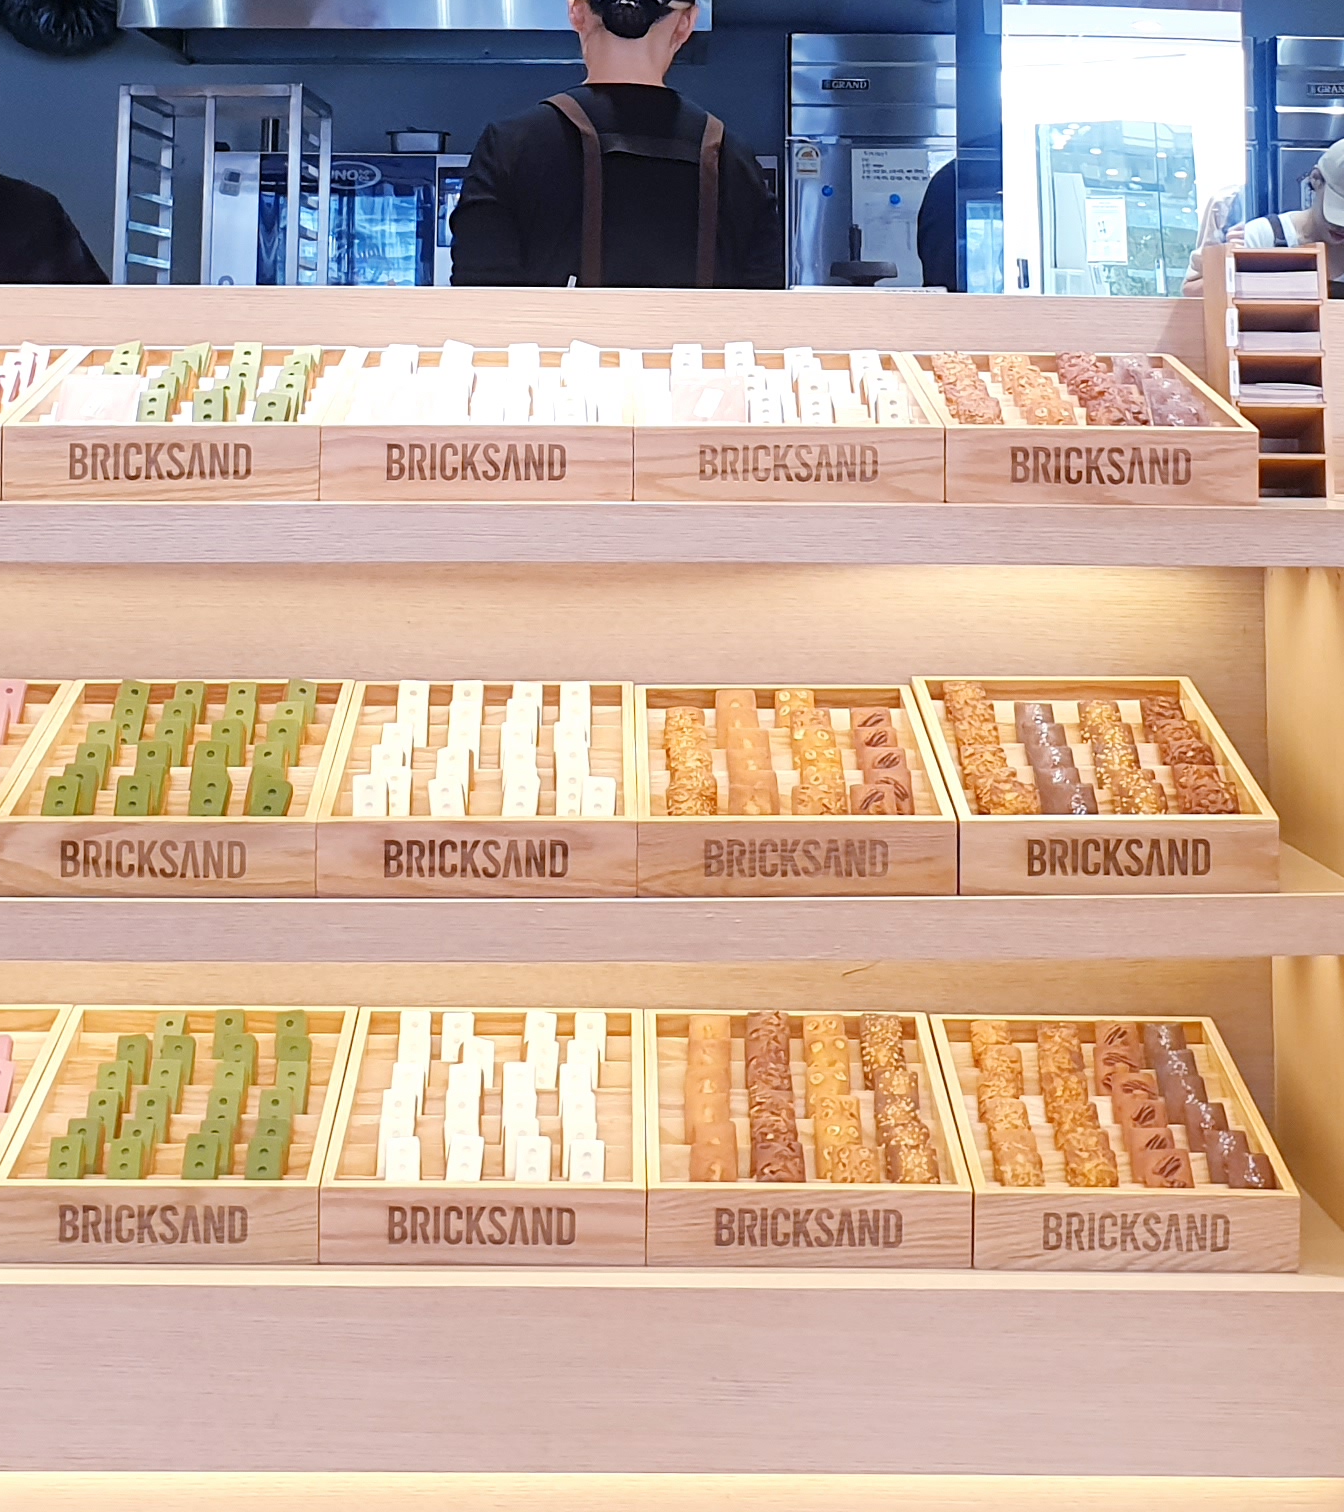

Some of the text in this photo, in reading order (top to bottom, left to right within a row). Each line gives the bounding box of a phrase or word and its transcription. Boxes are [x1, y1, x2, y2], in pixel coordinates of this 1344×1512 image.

[832, 80, 867, 90] GRAND
[69, 442, 252, 481] BRICKSAND
[386, 443, 566, 481] BRICKSAND
[699, 443, 878, 482] BRICKSAND
[1011, 446, 1192, 485] BRICKSAND
[60, 839, 246, 879] BRICKSAND
[382, 839, 569, 879] BRICKSAND
[702, 839, 889, 879] BRICKSAND
[1025, 837, 1212, 878] BRICKSAND
[58, 1207, 249, 1245] BRICKSAND
[387, 1206, 578, 1246] BRICKSAND
[713, 1209, 904, 1250] BRICKSAND
[1043, 1211, 1230, 1252] BRICKSAND
